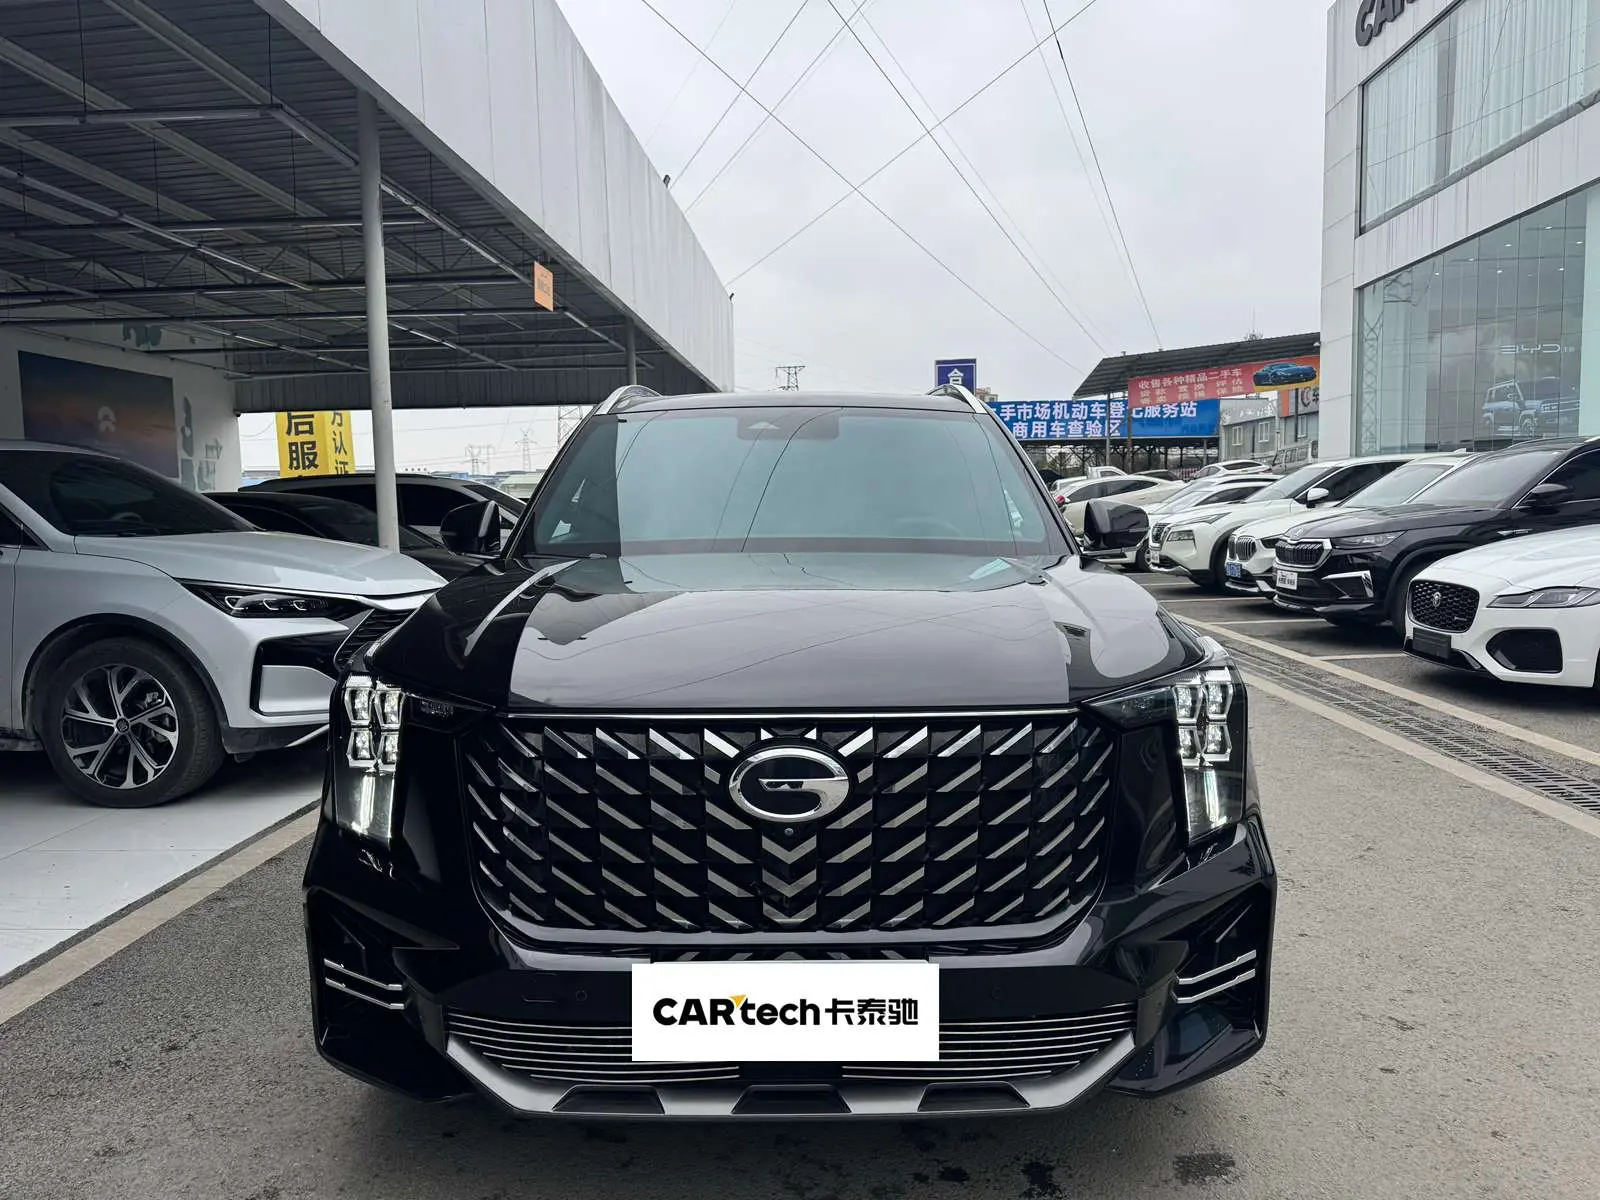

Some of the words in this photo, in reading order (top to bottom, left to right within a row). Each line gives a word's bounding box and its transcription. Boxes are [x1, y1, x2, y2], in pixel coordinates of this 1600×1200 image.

[1013, 420, 1121, 439] 商用车查验区
